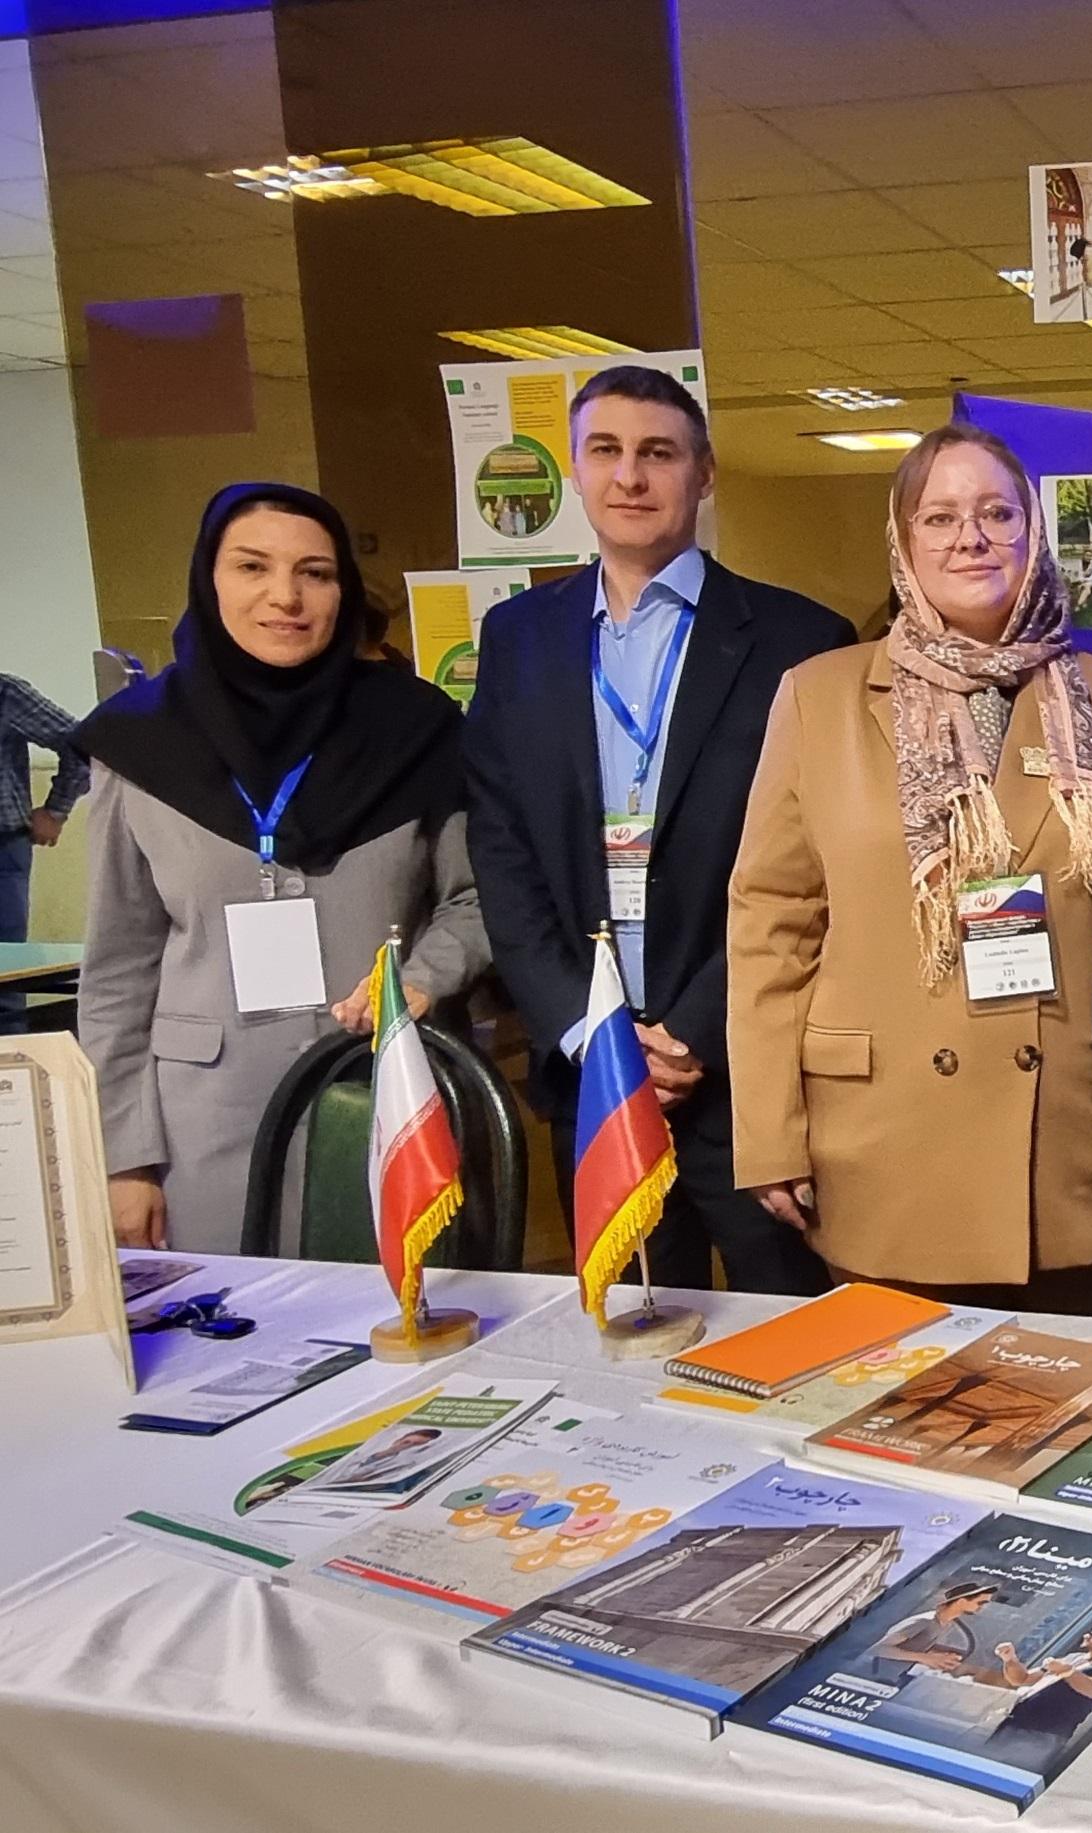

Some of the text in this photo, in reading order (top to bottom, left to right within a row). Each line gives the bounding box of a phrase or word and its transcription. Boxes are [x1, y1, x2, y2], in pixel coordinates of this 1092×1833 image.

[999, 1350, 1082, 1372] چارچوب
[774, 1485, 862, 1512] چارچوب
[825, 1704, 869, 1721] edition)
[773, 1716, 833, 1738] Intermediate
